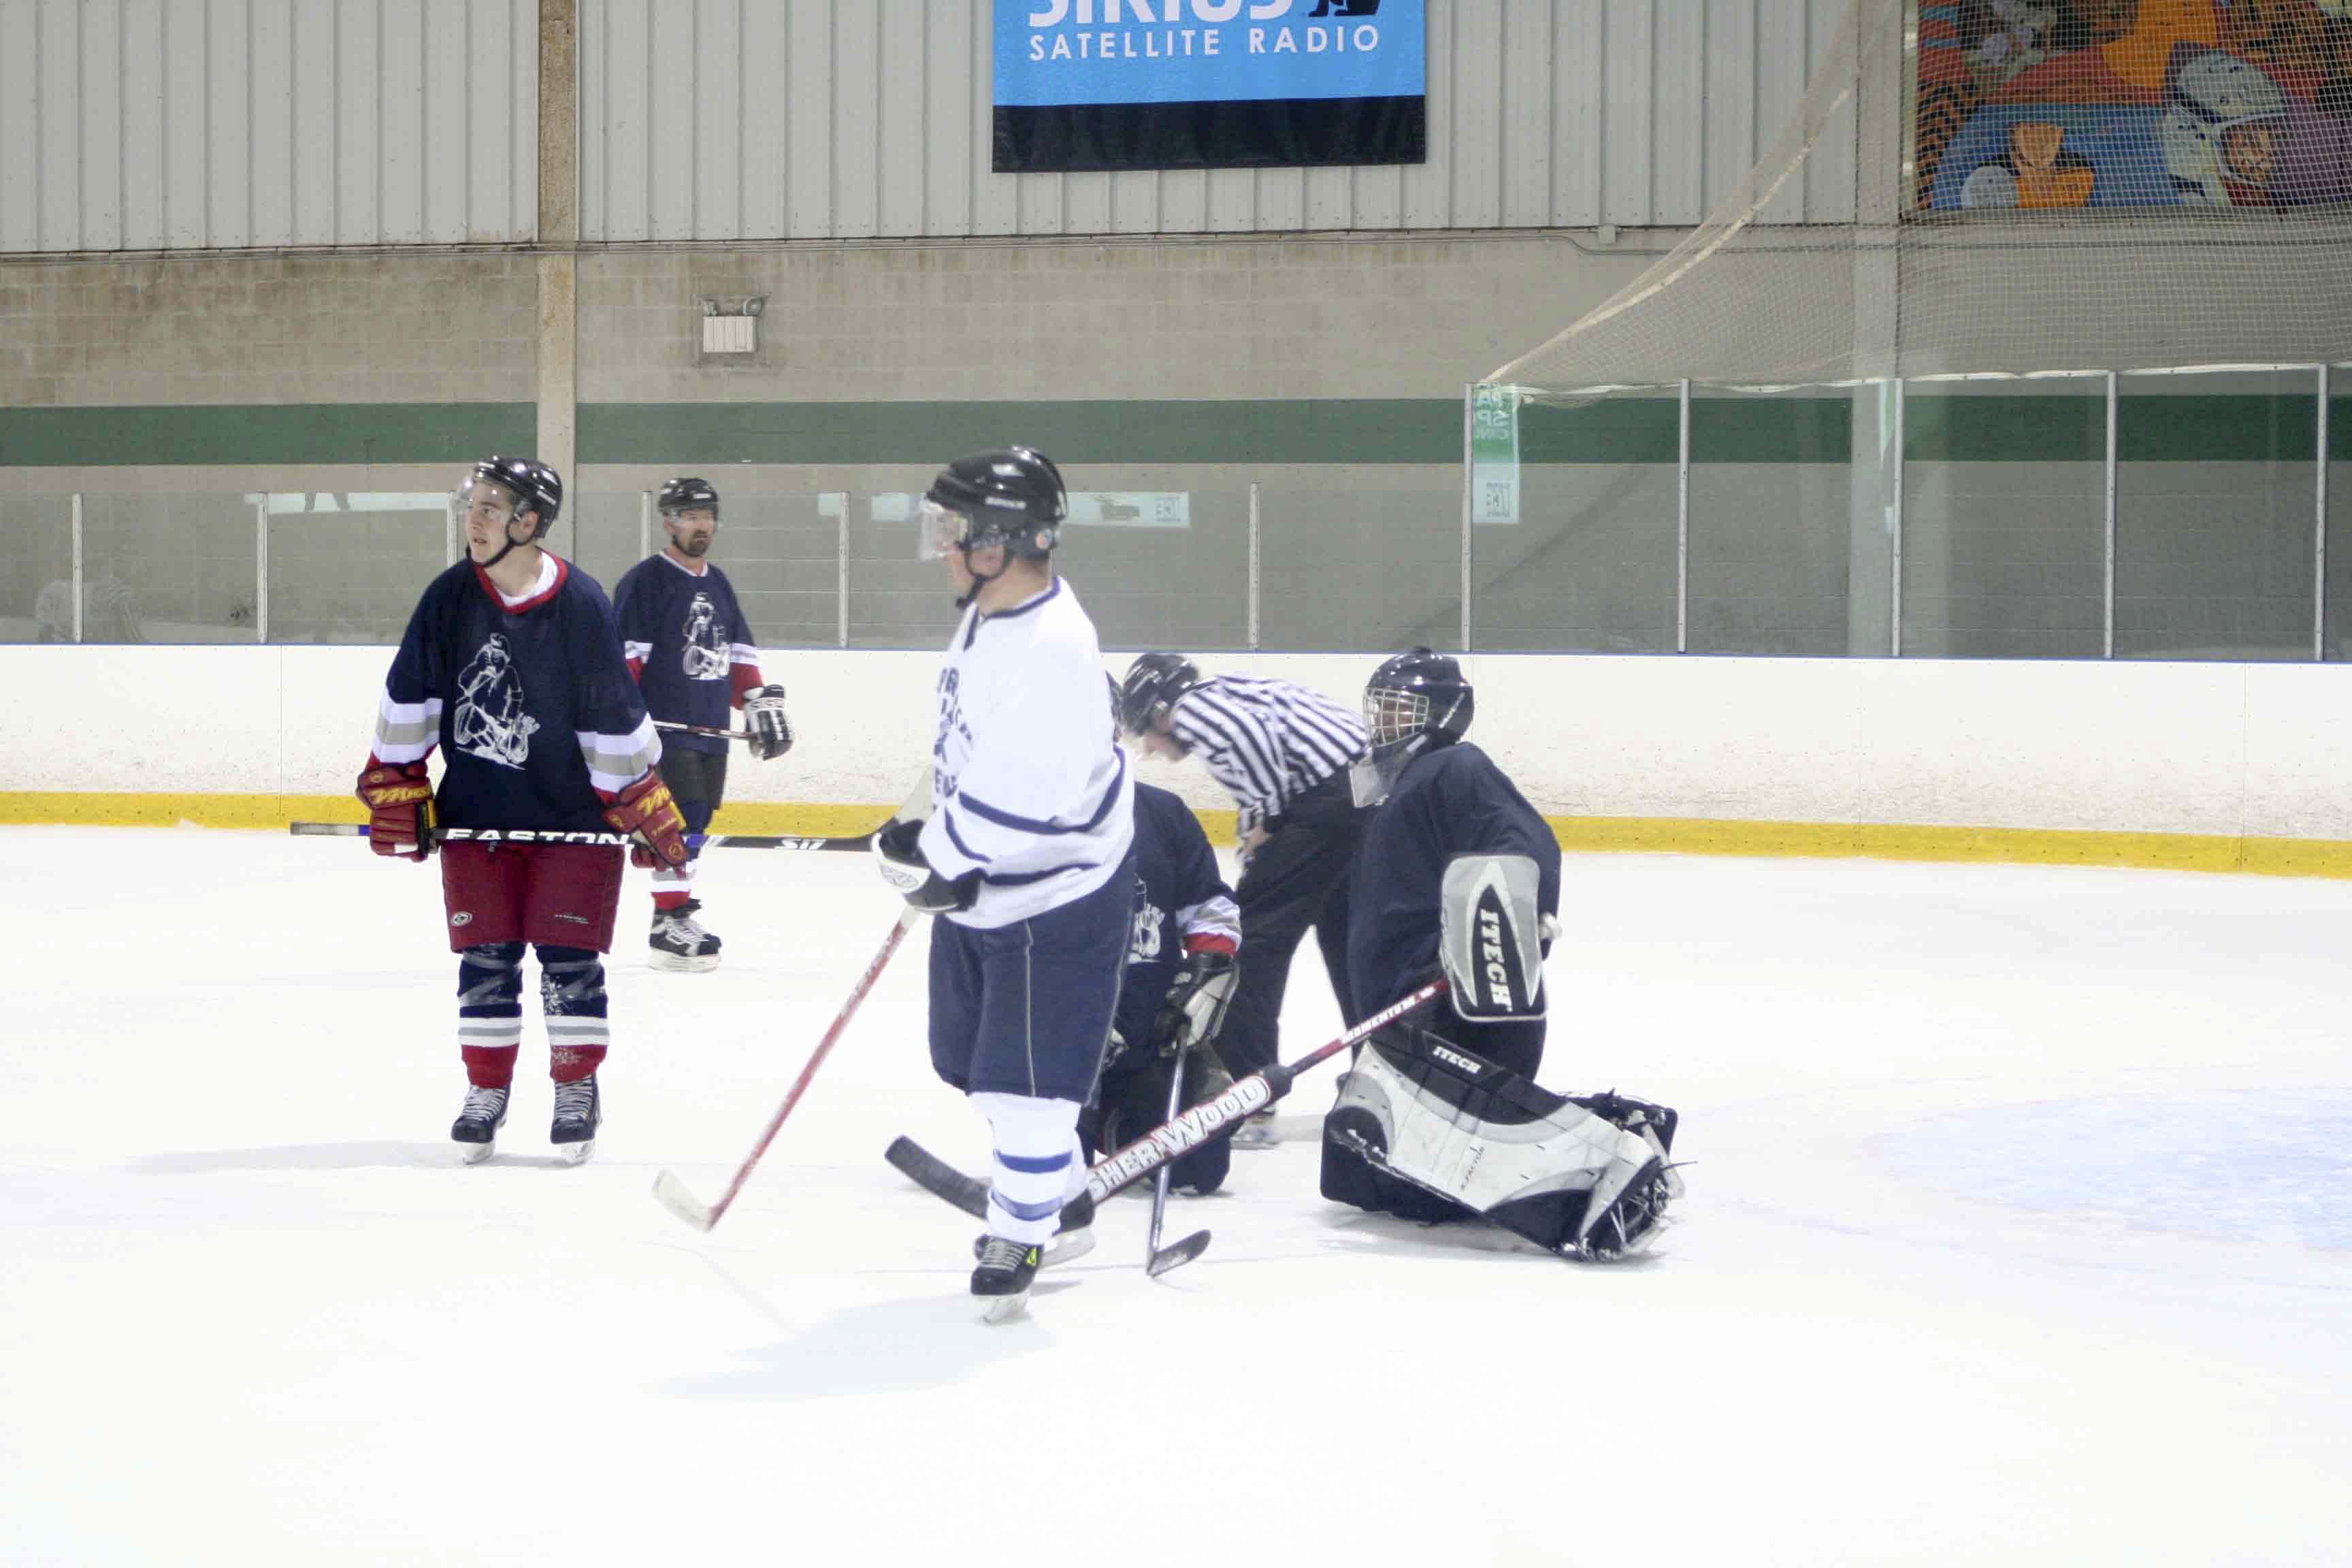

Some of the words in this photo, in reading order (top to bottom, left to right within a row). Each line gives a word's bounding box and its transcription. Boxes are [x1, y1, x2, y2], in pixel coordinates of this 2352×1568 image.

[1029, 29, 1220, 61] SATELLITE
[1249, 24, 1379, 54] RADIO
[1480, 909, 1513, 1012] ITECH
[1432, 1046, 1482, 1074] ITECH
